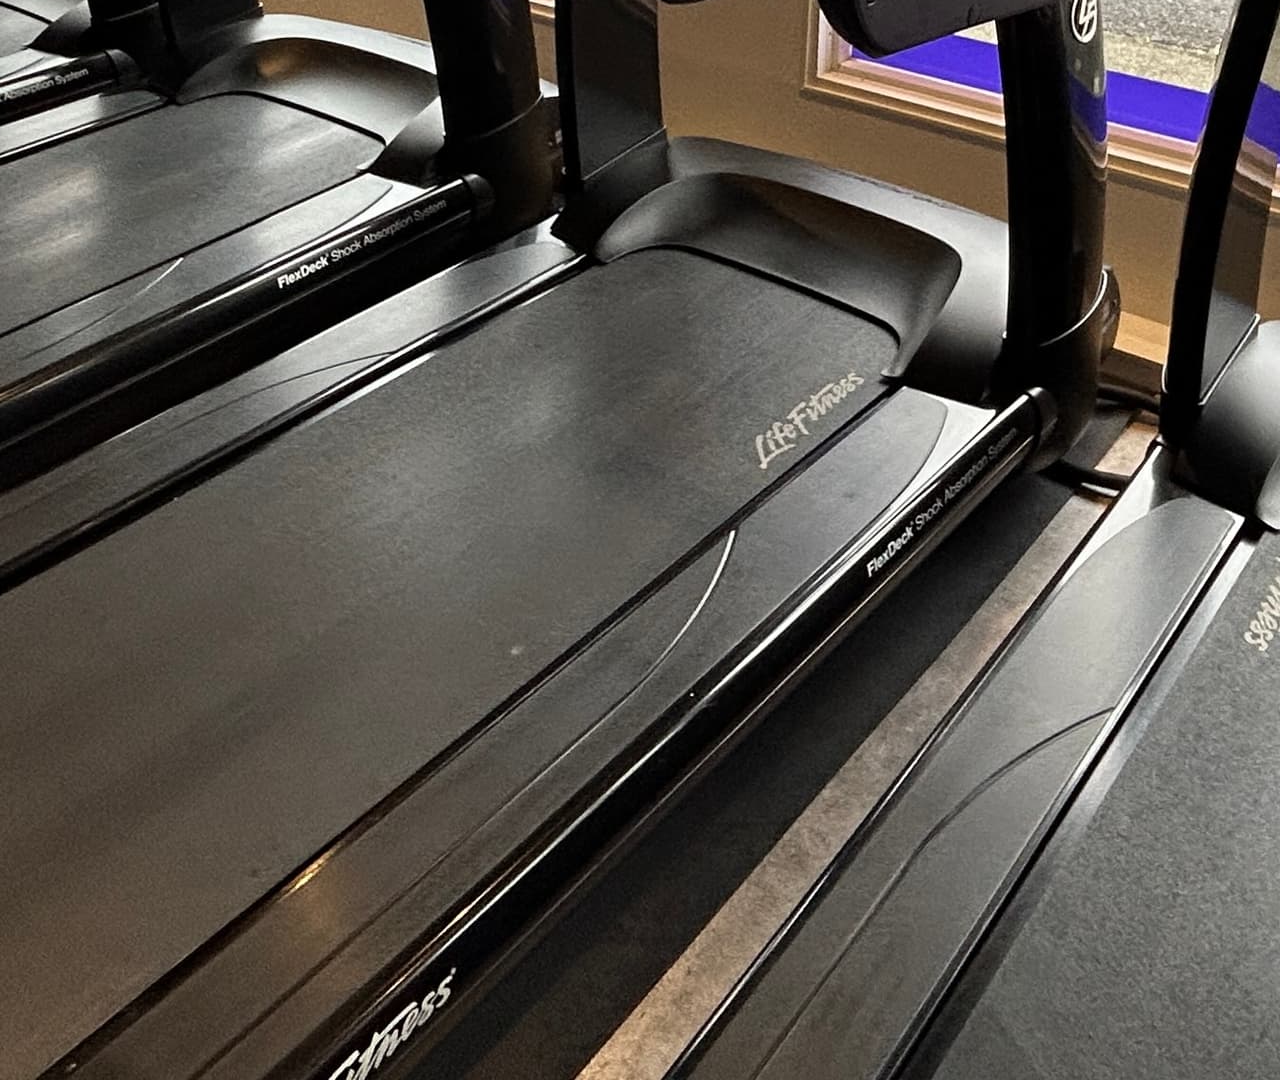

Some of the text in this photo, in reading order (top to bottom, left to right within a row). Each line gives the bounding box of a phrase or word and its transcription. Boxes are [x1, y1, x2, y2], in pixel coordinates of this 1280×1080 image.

[3, 77, 55, 103] Absorption
[54, 67, 89, 86] System
[277, 199, 448, 290] FlexDeck Shock Absorption System
[755, 371, 866, 470] Life Fitness
[866, 523, 915, 578] FlexDeck
[914, 496, 944, 531] Shock
[943, 454, 990, 504] Absorption
